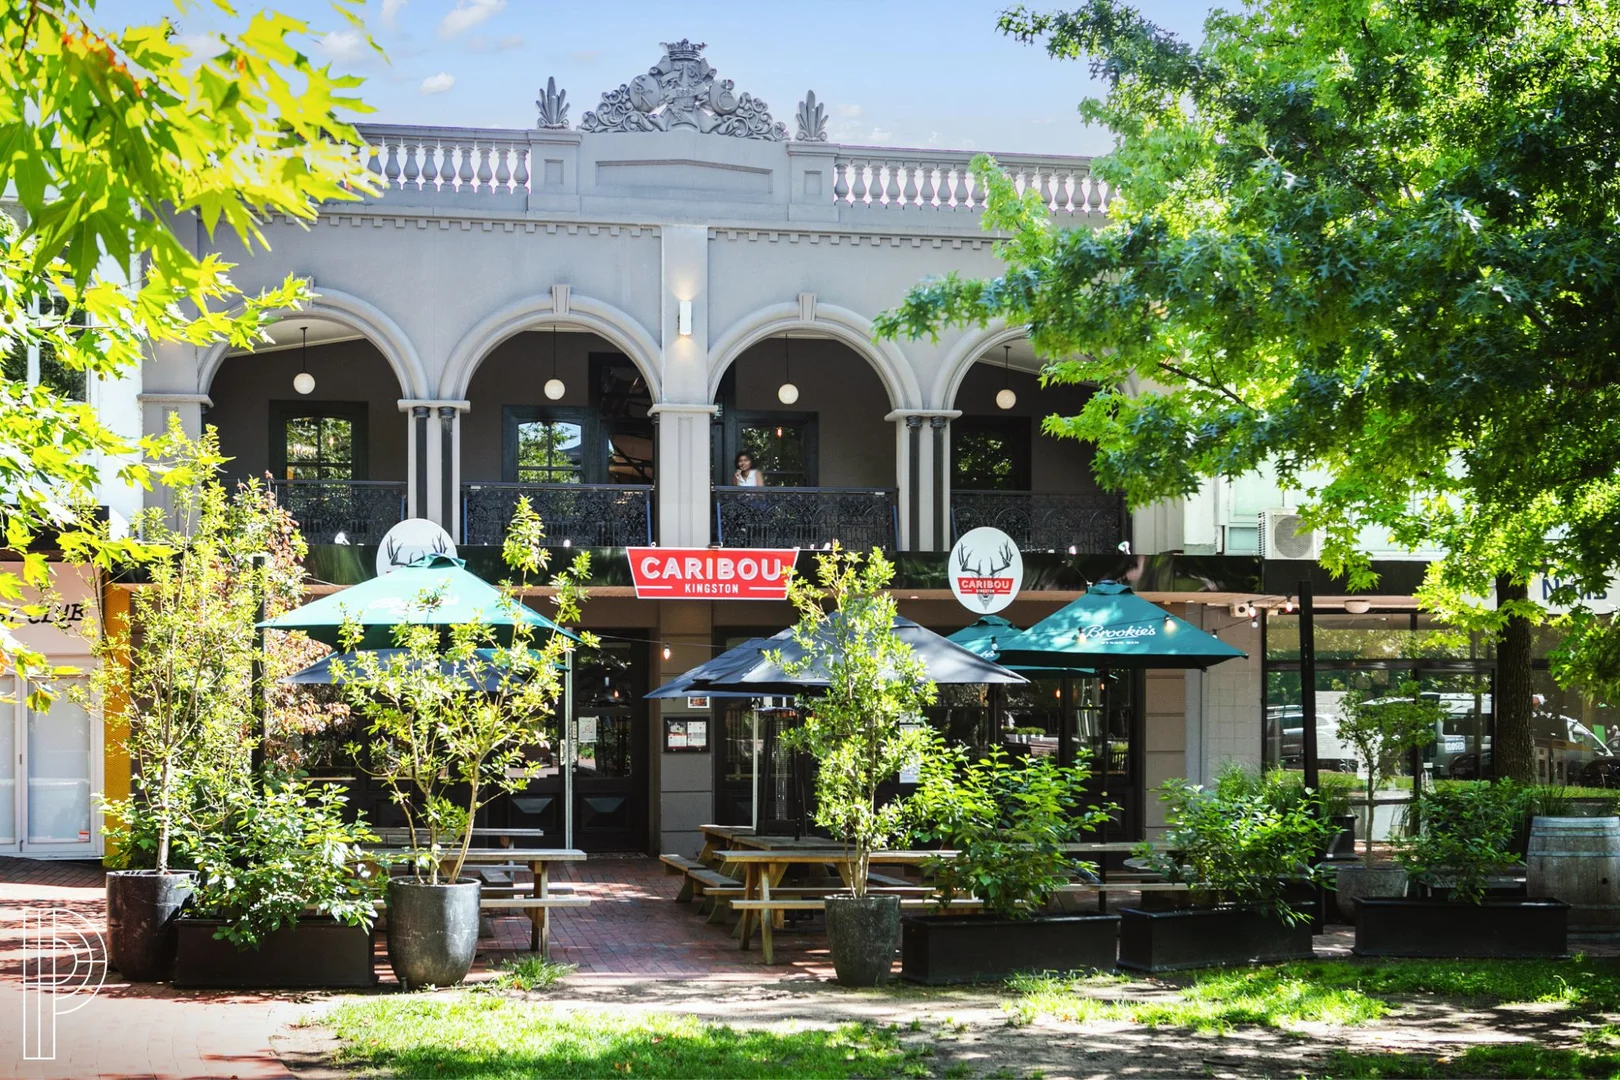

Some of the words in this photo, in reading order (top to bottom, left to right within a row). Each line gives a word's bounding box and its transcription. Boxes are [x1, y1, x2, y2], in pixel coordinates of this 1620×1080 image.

[640, 557, 781, 580] CARIBOU
[684, 583, 739, 594] KINGSTON
[961, 579, 1010, 589] CARIBOU
[1082, 624, 1156, 639] Brookie's
